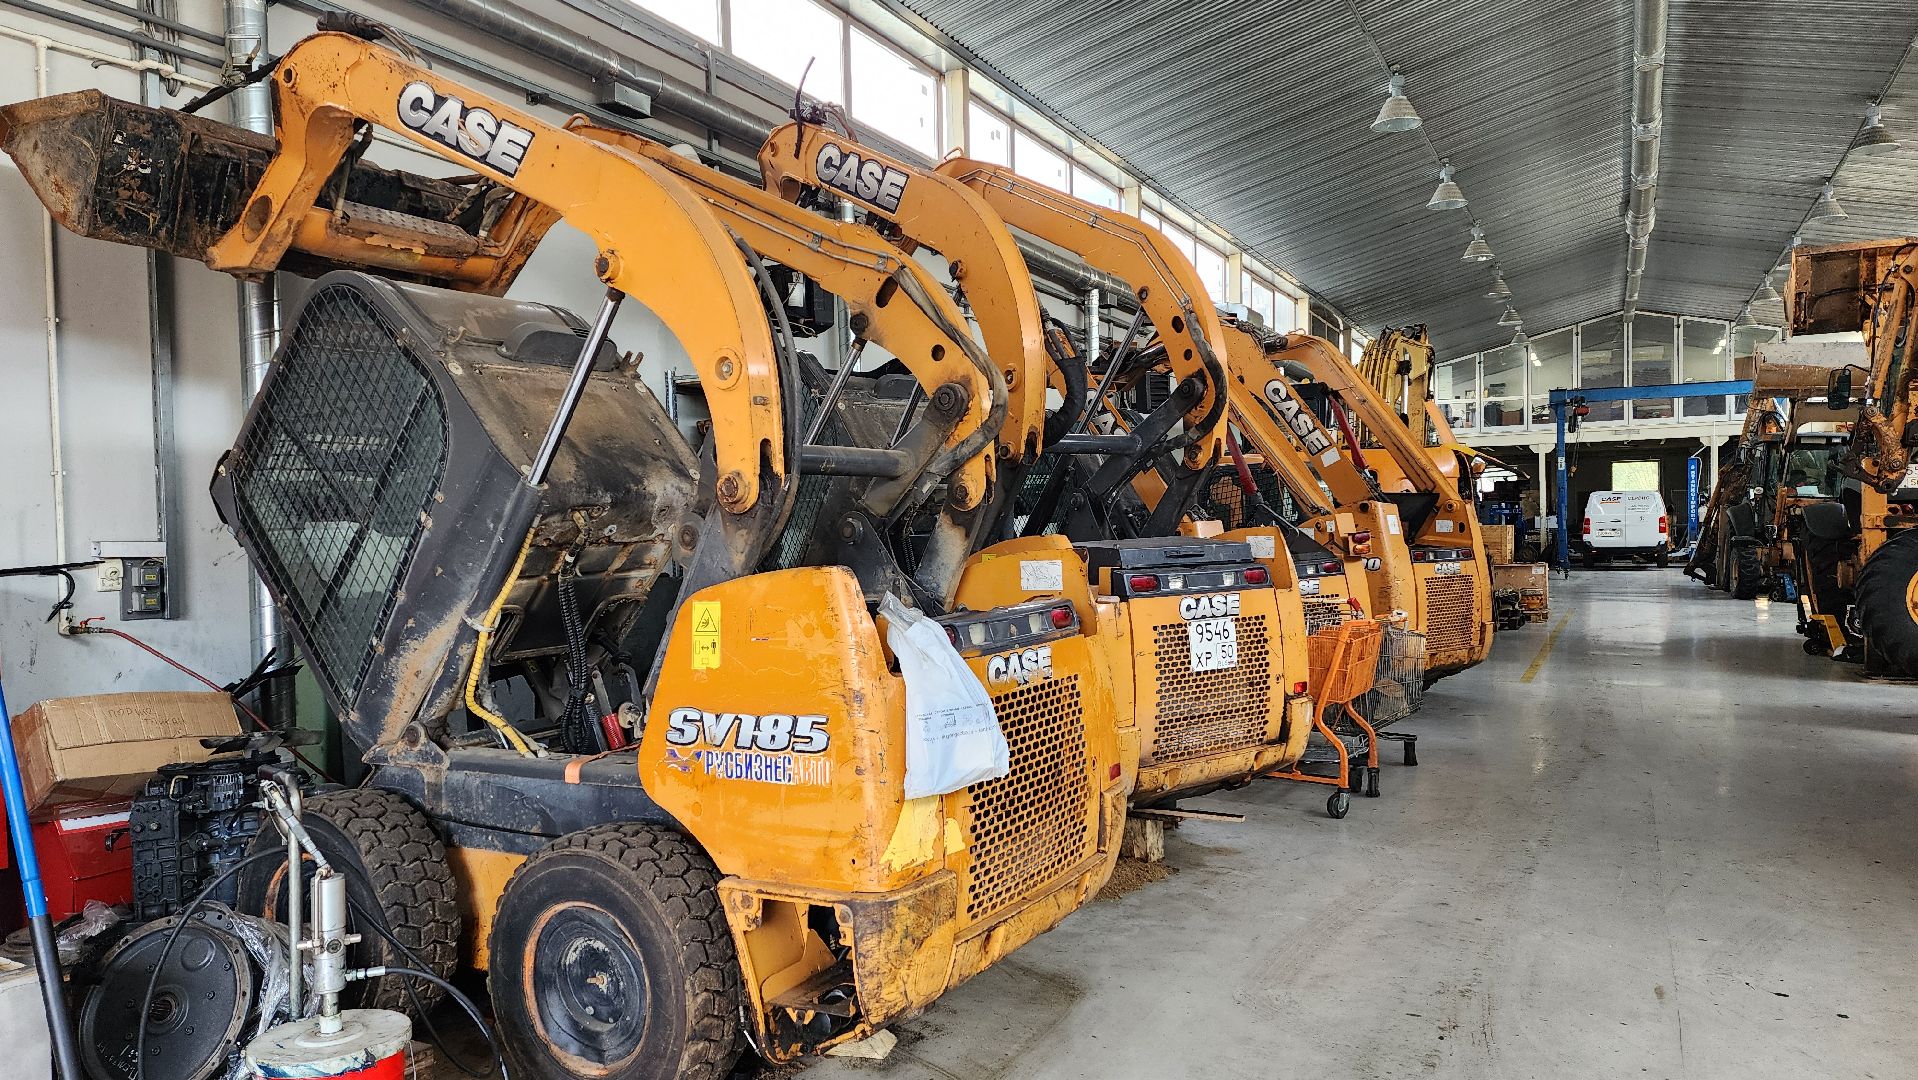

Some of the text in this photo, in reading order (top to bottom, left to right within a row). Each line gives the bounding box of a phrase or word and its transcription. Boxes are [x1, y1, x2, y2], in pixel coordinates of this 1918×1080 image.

[398, 79, 535, 178] CASE
[816, 142, 909, 214] CASE
[1264, 379, 1332, 456] CASE
[1434, 563, 1461, 575] CASE
[1179, 593, 1240, 620] CASE
[1196, 621, 1229, 643] 9546
[1221, 645, 1234, 659] 50
[987, 646, 1052, 687] CASE
[666, 707, 830, 753] SV185
